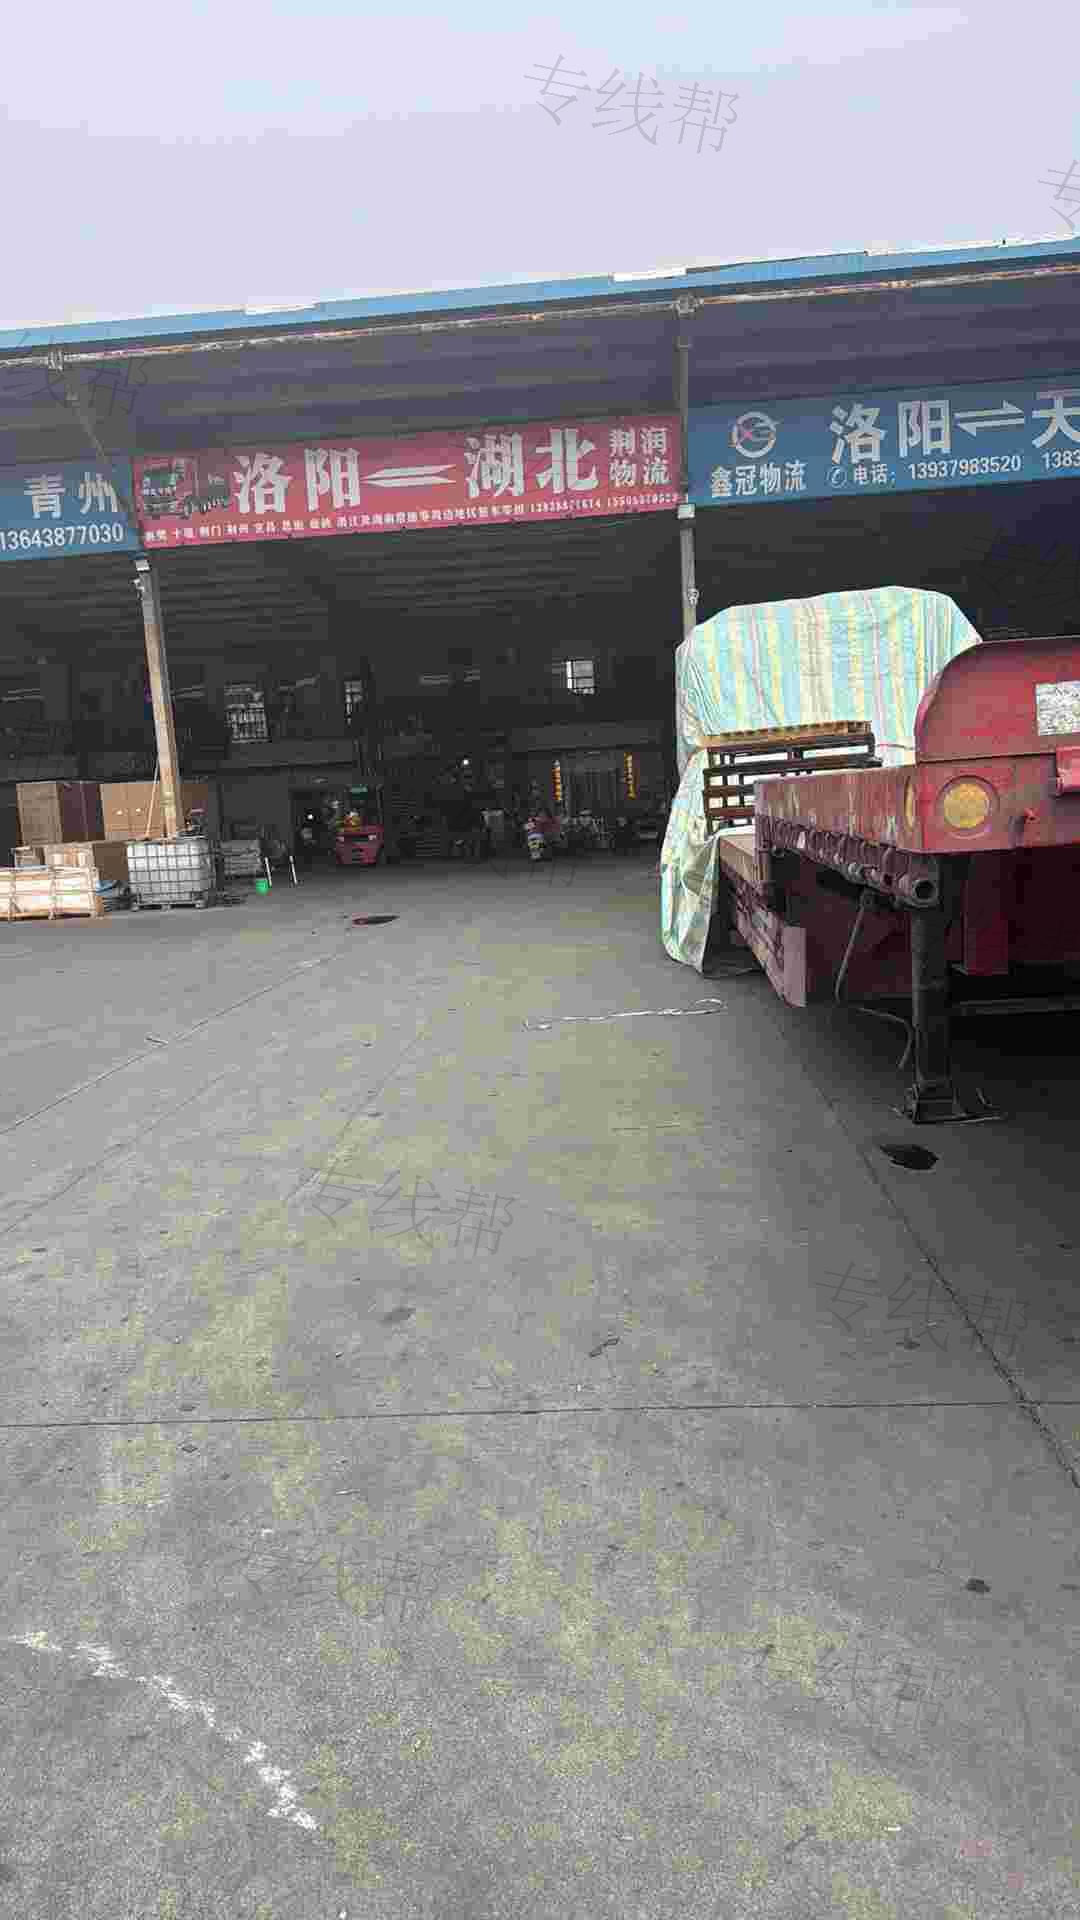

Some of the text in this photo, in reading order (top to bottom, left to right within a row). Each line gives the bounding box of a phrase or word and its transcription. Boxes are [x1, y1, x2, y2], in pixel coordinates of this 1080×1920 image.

[829, 400, 951, 464] 洛阳
[234, 428, 599, 514] 洛阳 湖北
[609, 457, 672, 488] 物流
[711, 459, 807, 498] 鑫冠物流
[907, 455, 1021, 480] 13937983520
[24, 471, 119, 519] 青州
[0, 522, 124, 551] 13643877030
